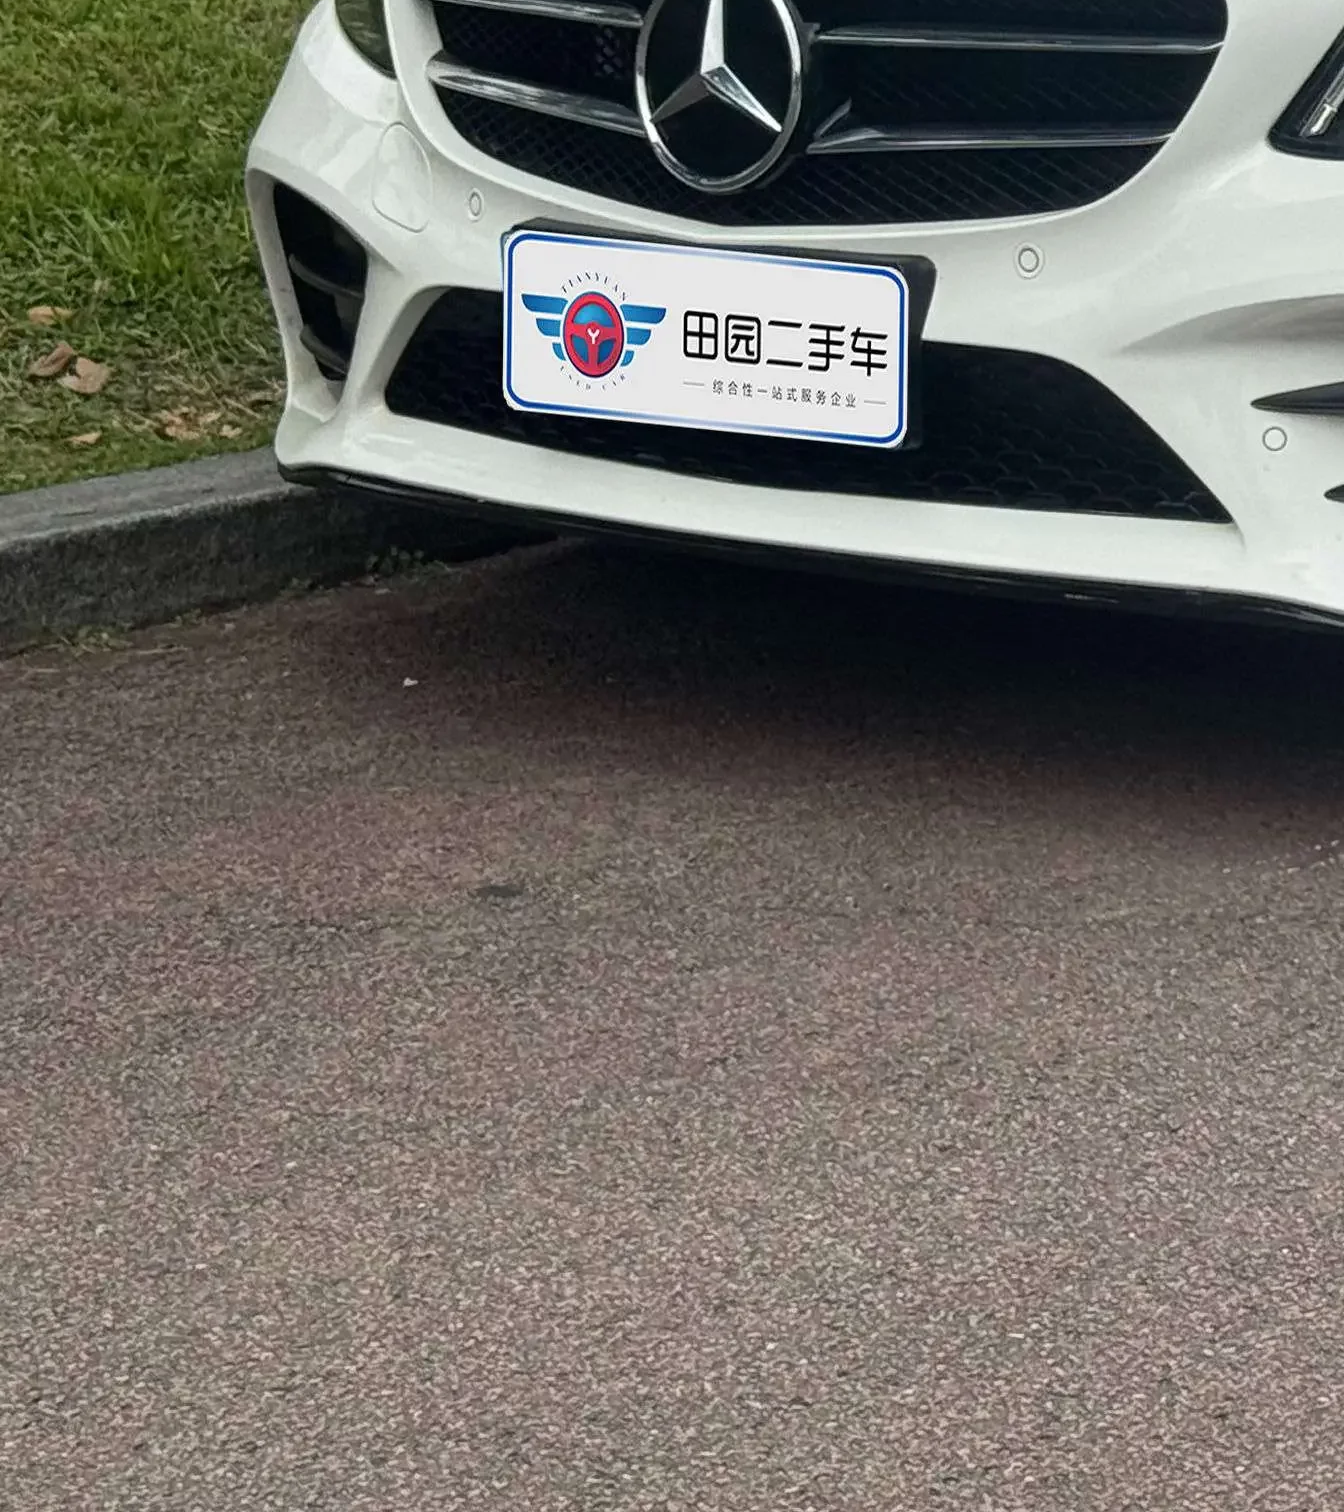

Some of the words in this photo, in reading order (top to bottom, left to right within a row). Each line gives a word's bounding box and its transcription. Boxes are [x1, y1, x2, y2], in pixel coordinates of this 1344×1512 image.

[586, 328, 601, 345] Y
[683, 310, 888, 376] 田园二手车
[712, 379, 857, 408] 综合性一站式服务企业
